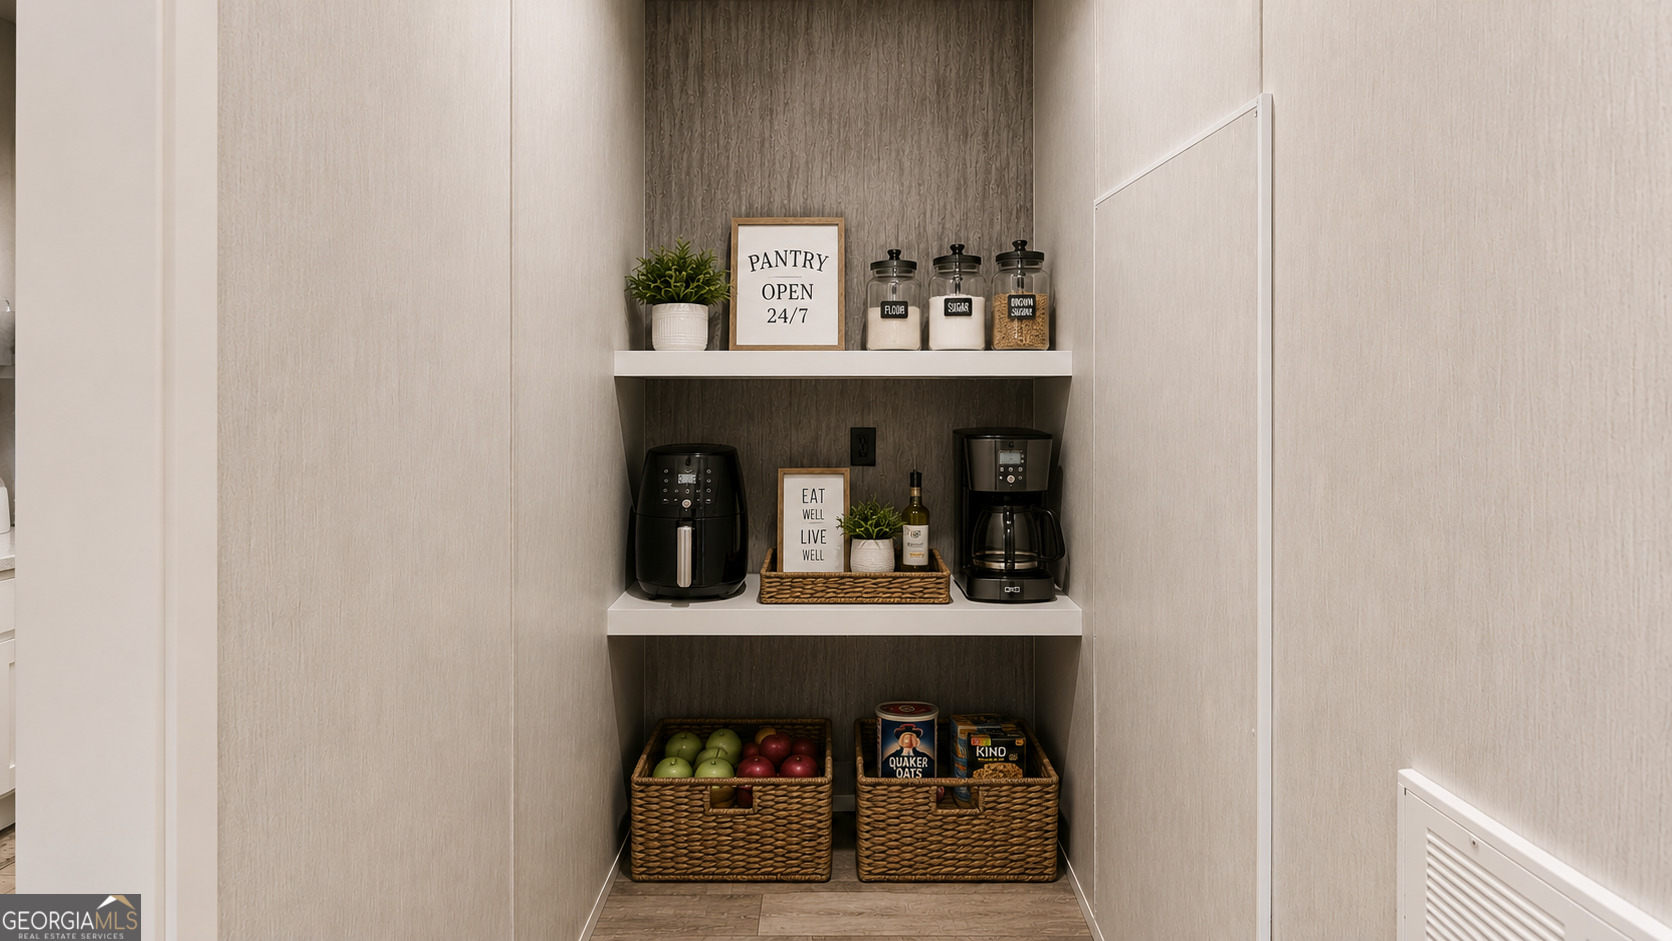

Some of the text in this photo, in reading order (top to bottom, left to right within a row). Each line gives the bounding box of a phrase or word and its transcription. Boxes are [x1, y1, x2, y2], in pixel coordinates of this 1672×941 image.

[748, 249, 829, 272] PANTRY
[761, 283, 813, 301] OPEN
[947, 302, 969, 313] SUGAR
[767, 307, 808, 324] 24/7
[802, 488, 825, 504] EAT
[802, 508, 824, 520] WELL
[800, 529, 827, 544] LIVE
[802, 549, 824, 561] WELL
[976, 746, 1007, 757] KIND
[889, 756, 928, 770] QUAKER
[896, 768, 923, 779] OATS
